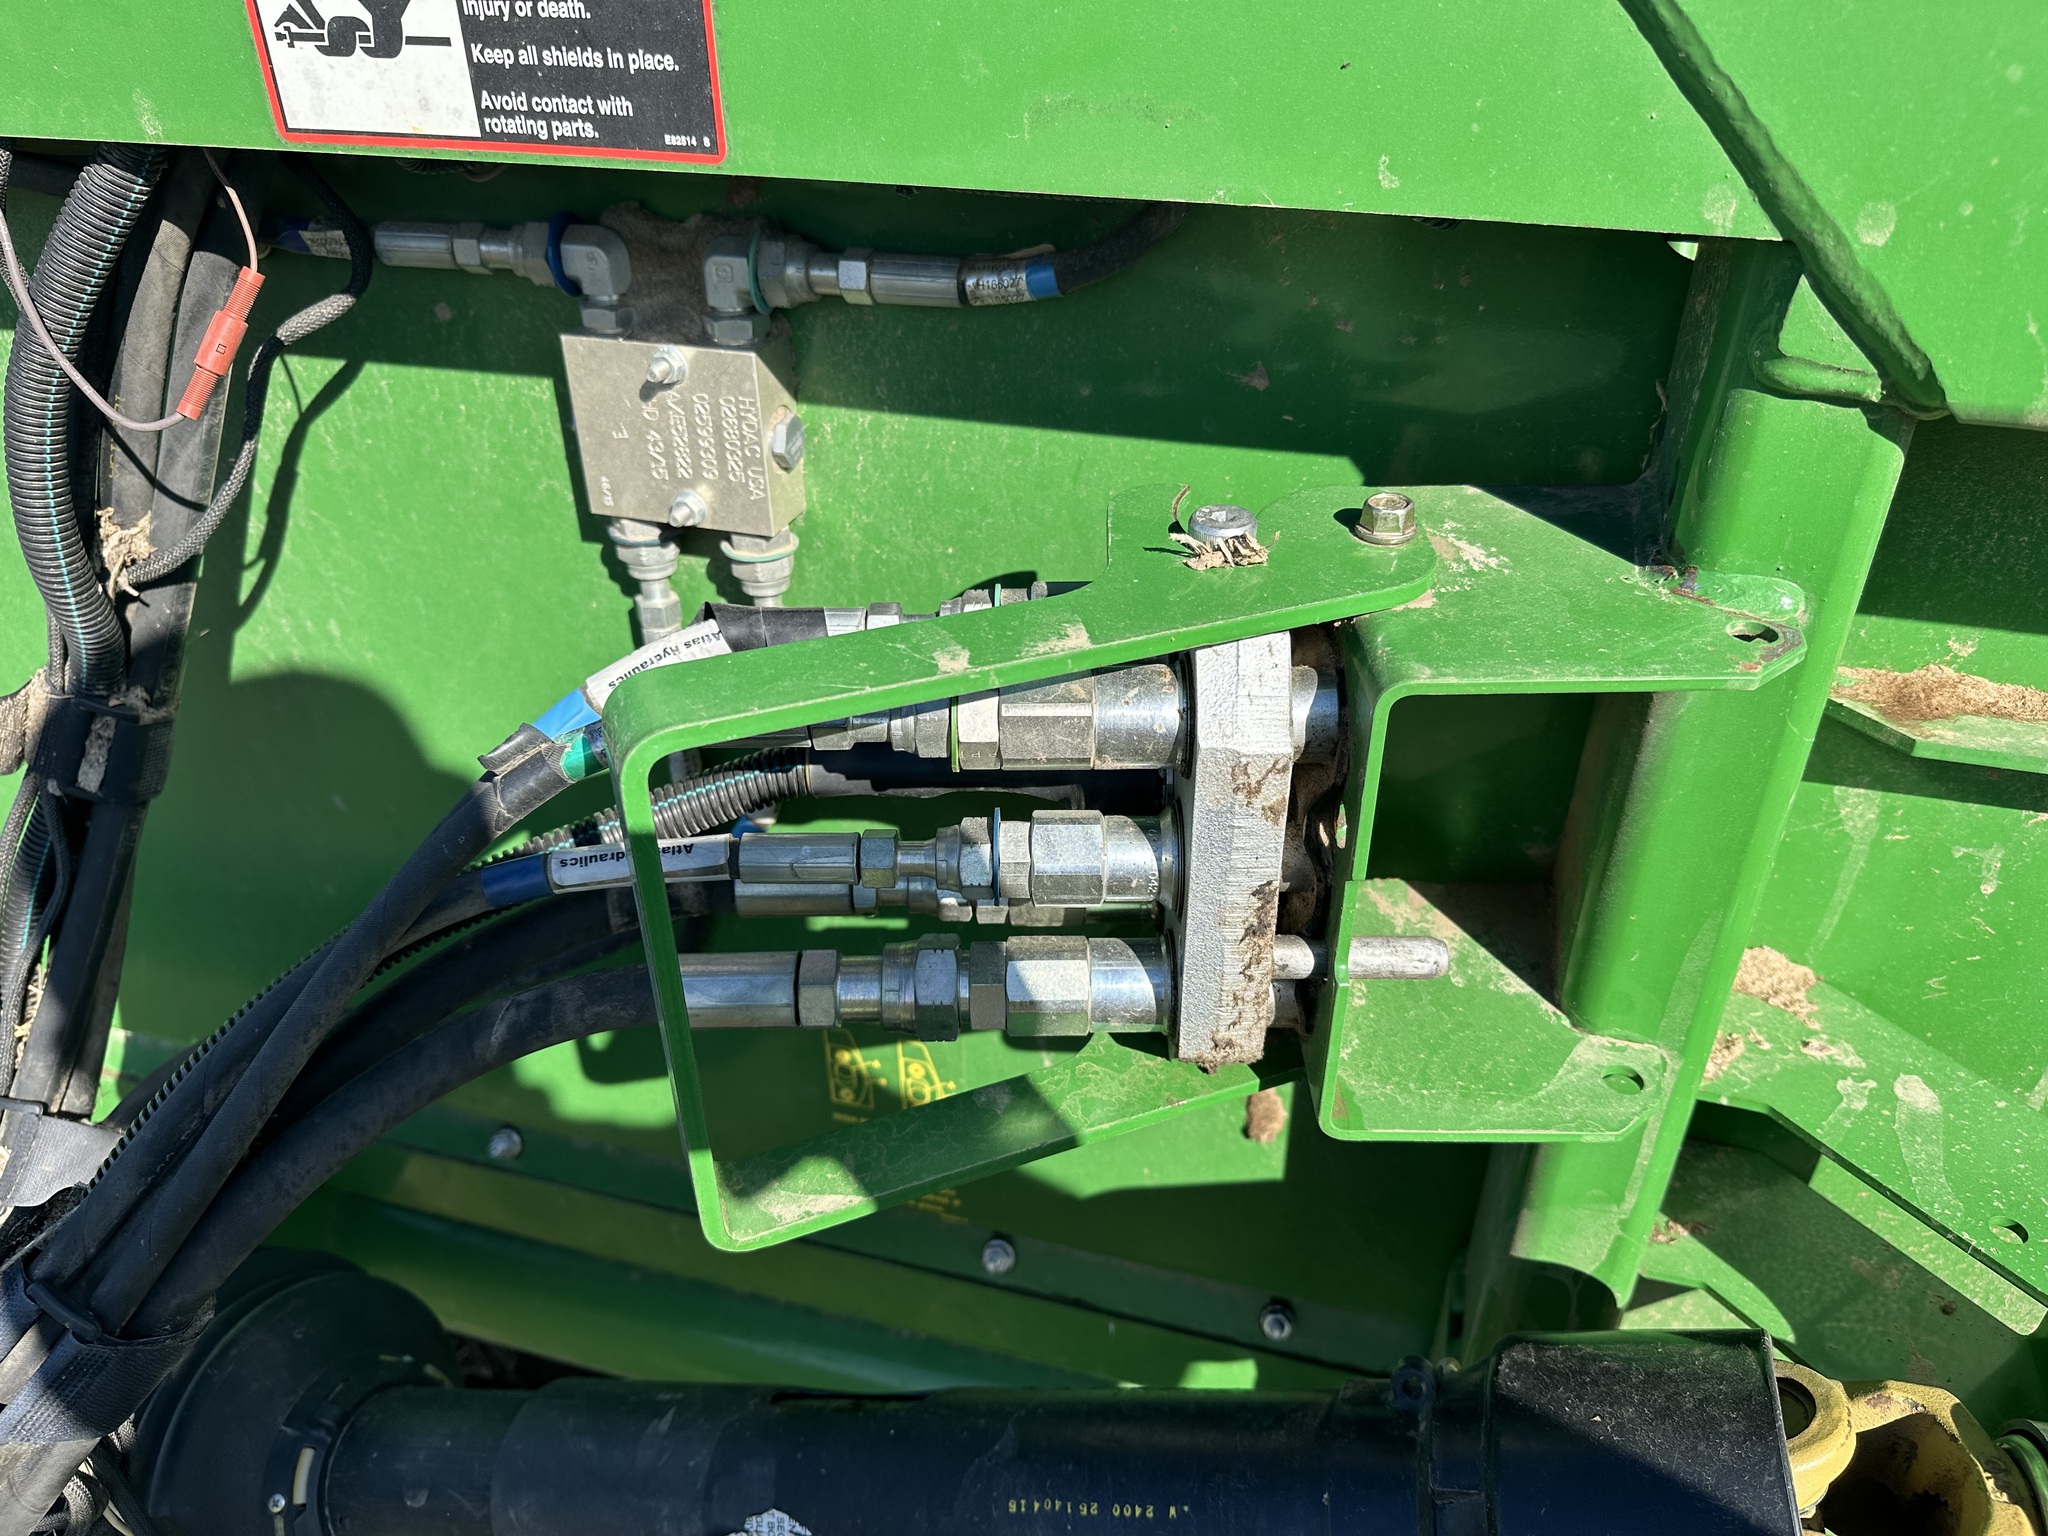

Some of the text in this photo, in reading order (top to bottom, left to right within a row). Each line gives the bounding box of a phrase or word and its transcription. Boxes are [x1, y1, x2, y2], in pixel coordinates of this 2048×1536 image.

[515, 1, 532, 18] or
[537, 0, 591, 19] death.
[471, 43, 679, 74] Keep all shields in place.
[481, 90, 633, 117] Avoid contact with
[484, 115, 599, 141] rotating parts.
[738, 395, 766, 501] HYDAC USA
[684, 630, 724, 649] Atlas
[560, 843, 694, 868] Atla draulics
[1112, 1503, 1154, 1518] 2400
